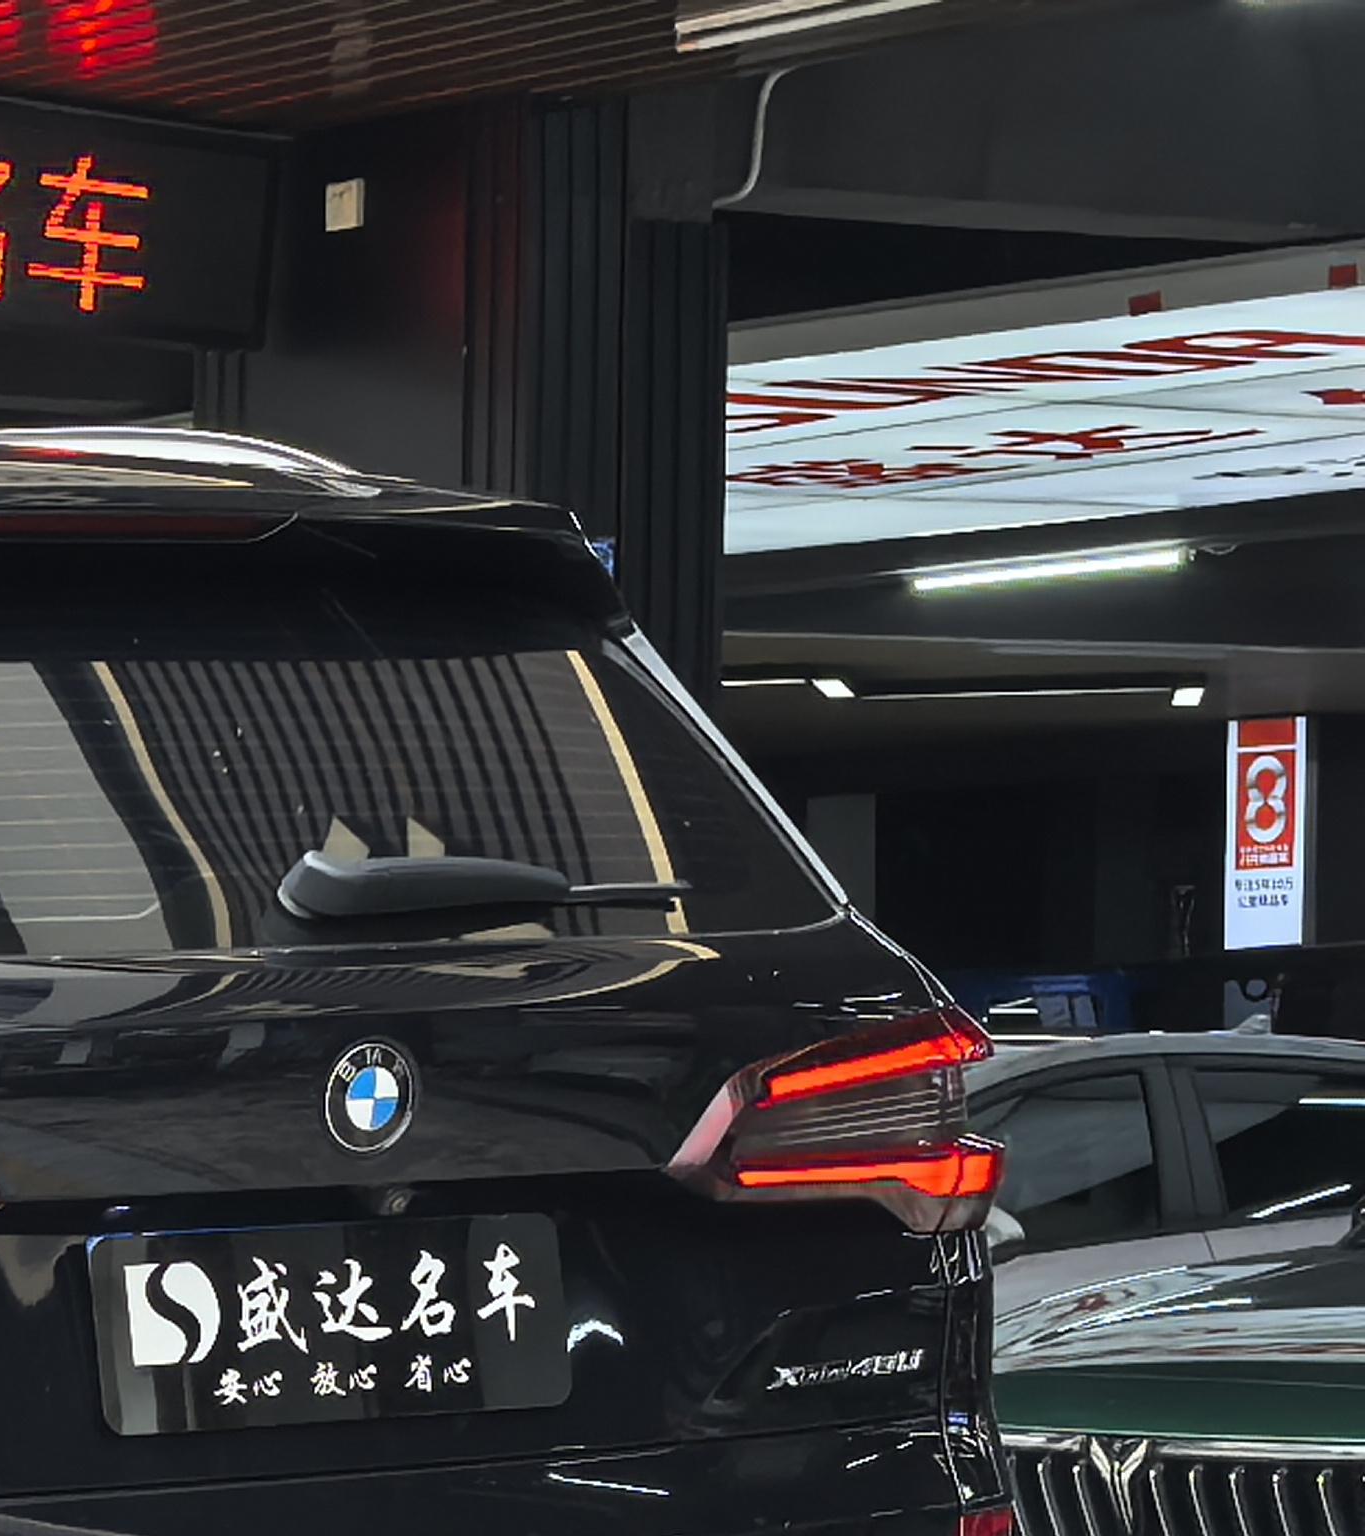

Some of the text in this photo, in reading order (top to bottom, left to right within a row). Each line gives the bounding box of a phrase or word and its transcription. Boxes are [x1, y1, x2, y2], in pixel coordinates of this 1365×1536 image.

[237, 1242, 536, 1355] 盛达名车
[213, 1355, 472, 1405] 安心 放心 省心
